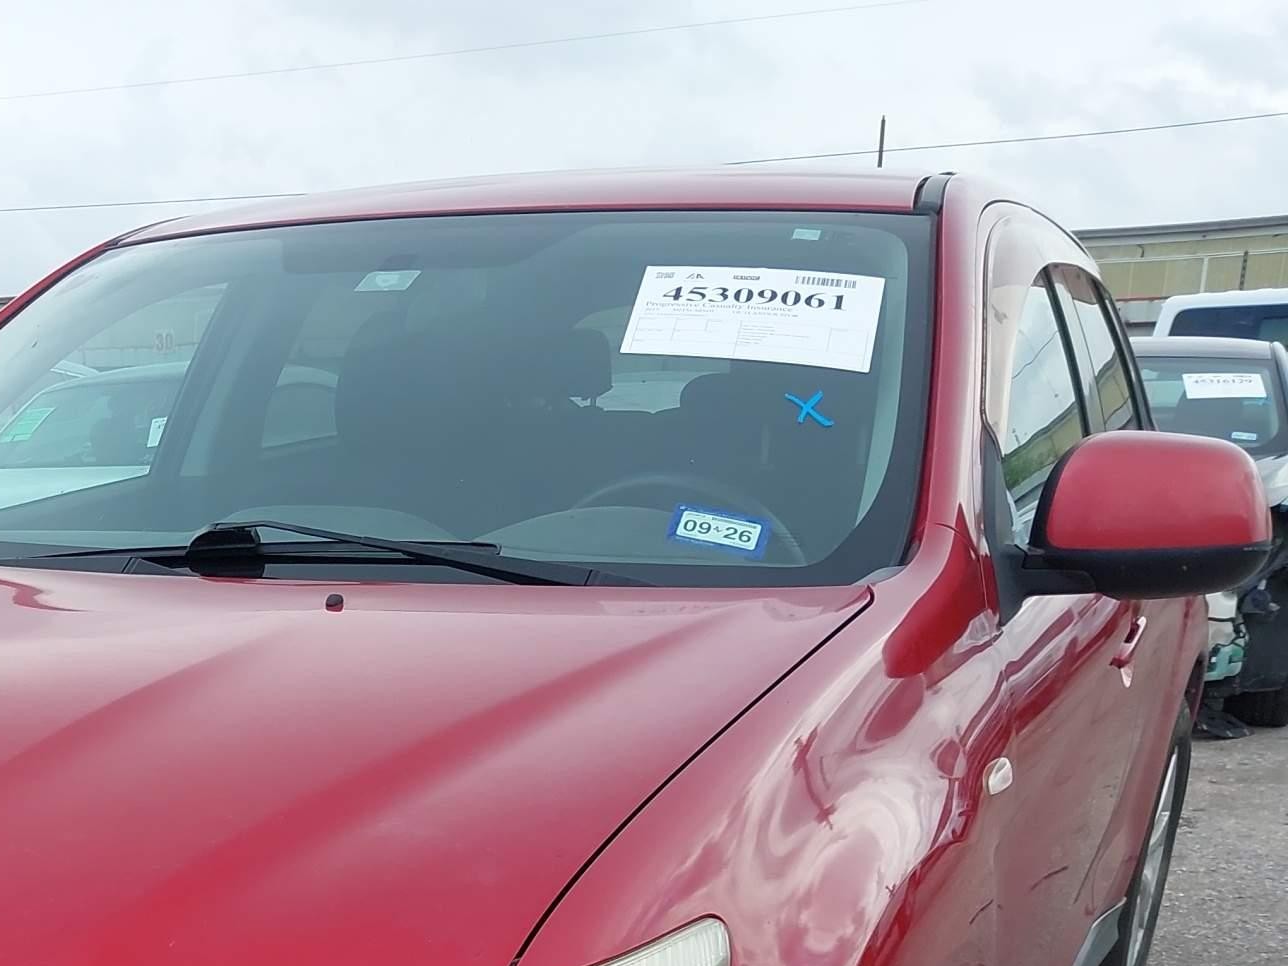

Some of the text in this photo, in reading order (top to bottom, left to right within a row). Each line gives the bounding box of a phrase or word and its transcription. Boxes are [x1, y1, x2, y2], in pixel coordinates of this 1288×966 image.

[646, 300, 700, 309] Progressive
[747, 304, 793, 313] Insurance
[662, 285, 847, 311] 45309061
[683, 519, 712, 535] 09
[722, 526, 753, 543] 26
